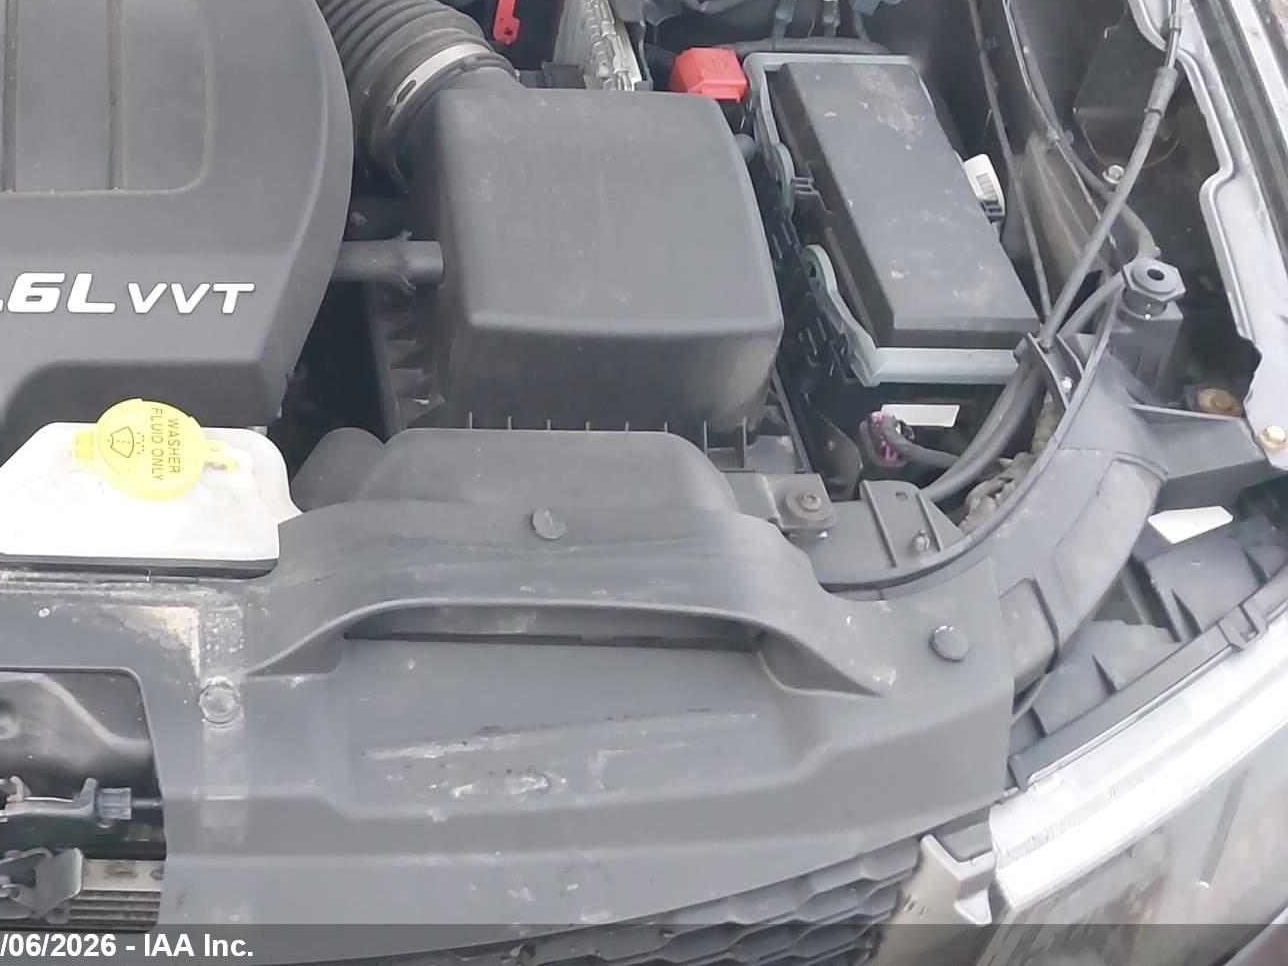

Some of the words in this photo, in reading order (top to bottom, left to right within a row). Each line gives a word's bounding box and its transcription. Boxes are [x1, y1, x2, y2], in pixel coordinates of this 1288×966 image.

[127, 282, 256, 314] VVT
[151, 407, 163, 444] FLUID
[168, 418, 181, 474] WASHER
[152, 448, 164, 481] ONLY
